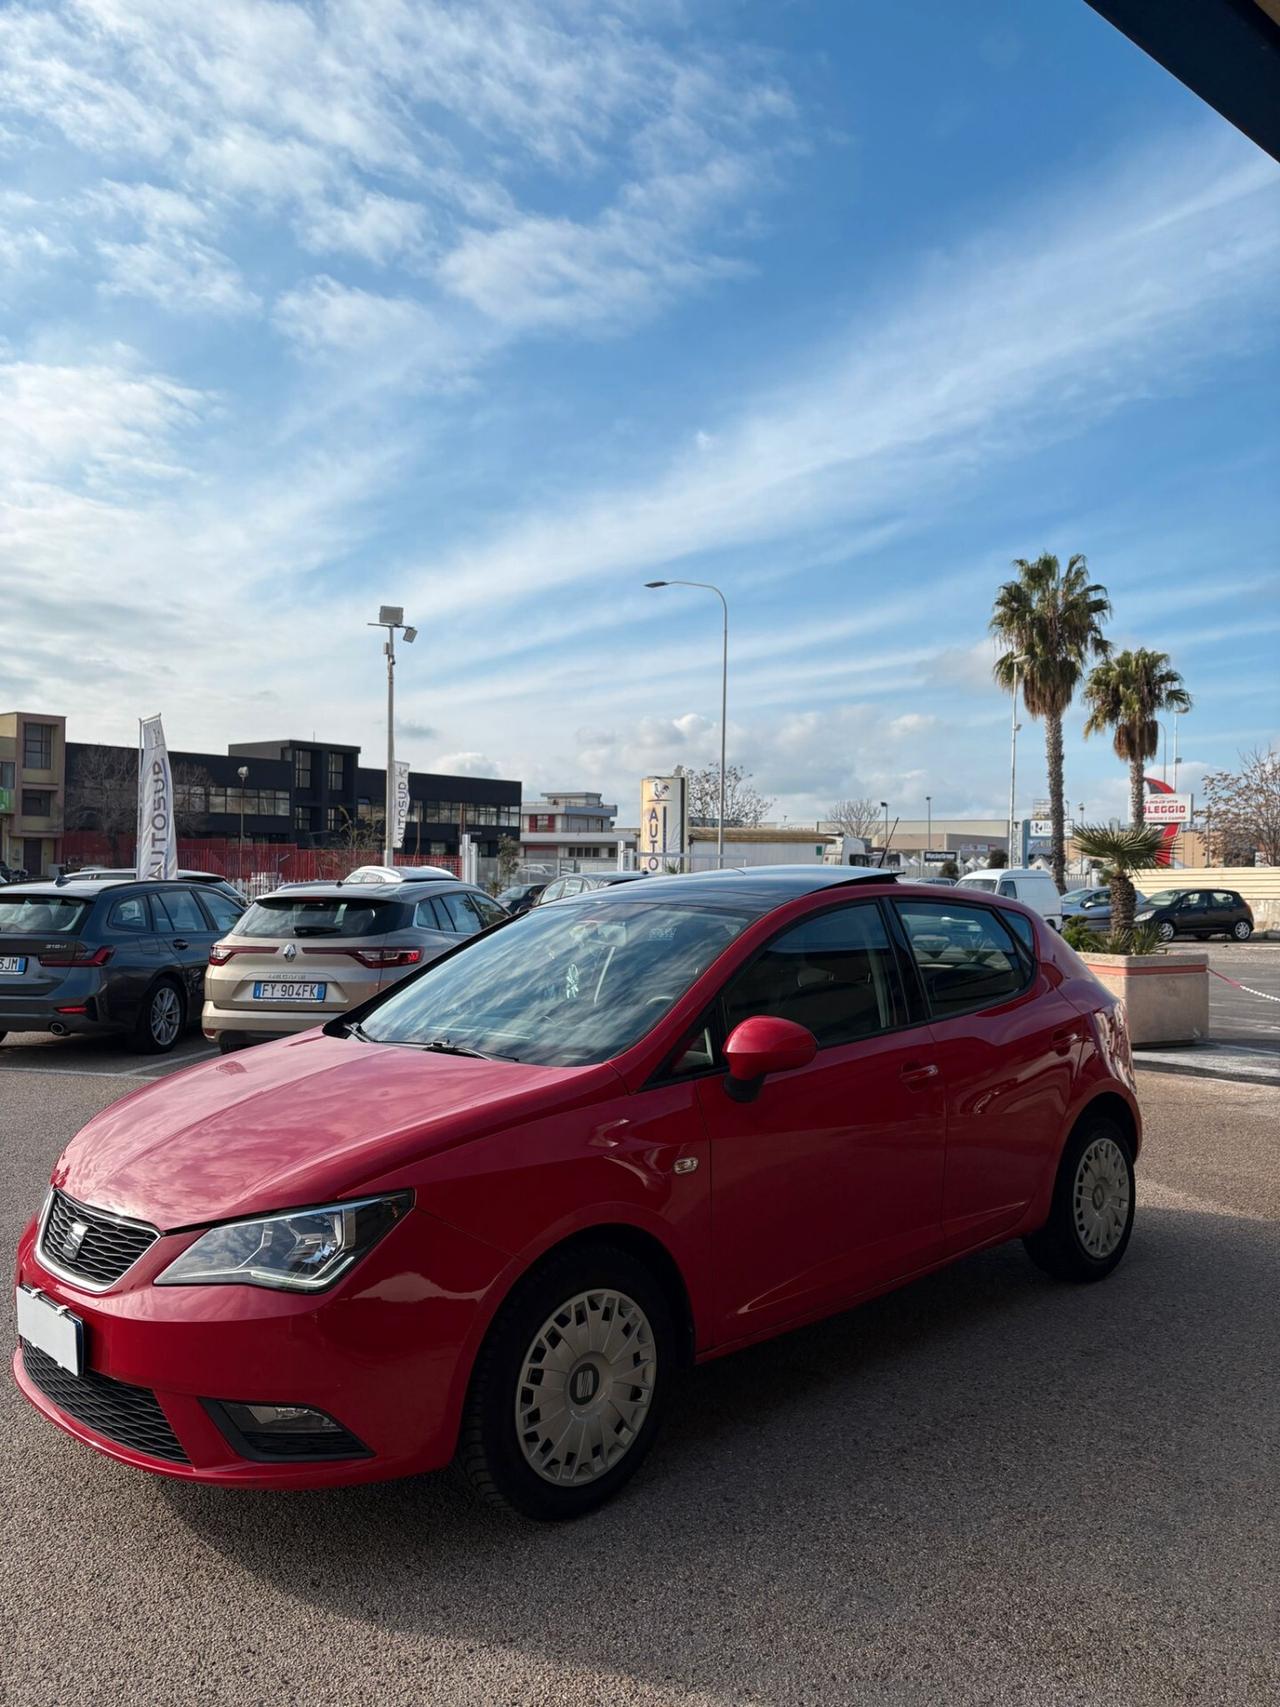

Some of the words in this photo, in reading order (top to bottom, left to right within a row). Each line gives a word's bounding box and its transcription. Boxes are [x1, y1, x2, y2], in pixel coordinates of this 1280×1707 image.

[148, 760, 167, 880] AUTOSUD
[649, 807, 659, 871] AUTO
[1140, 805, 1186, 814] OLEGGIO
